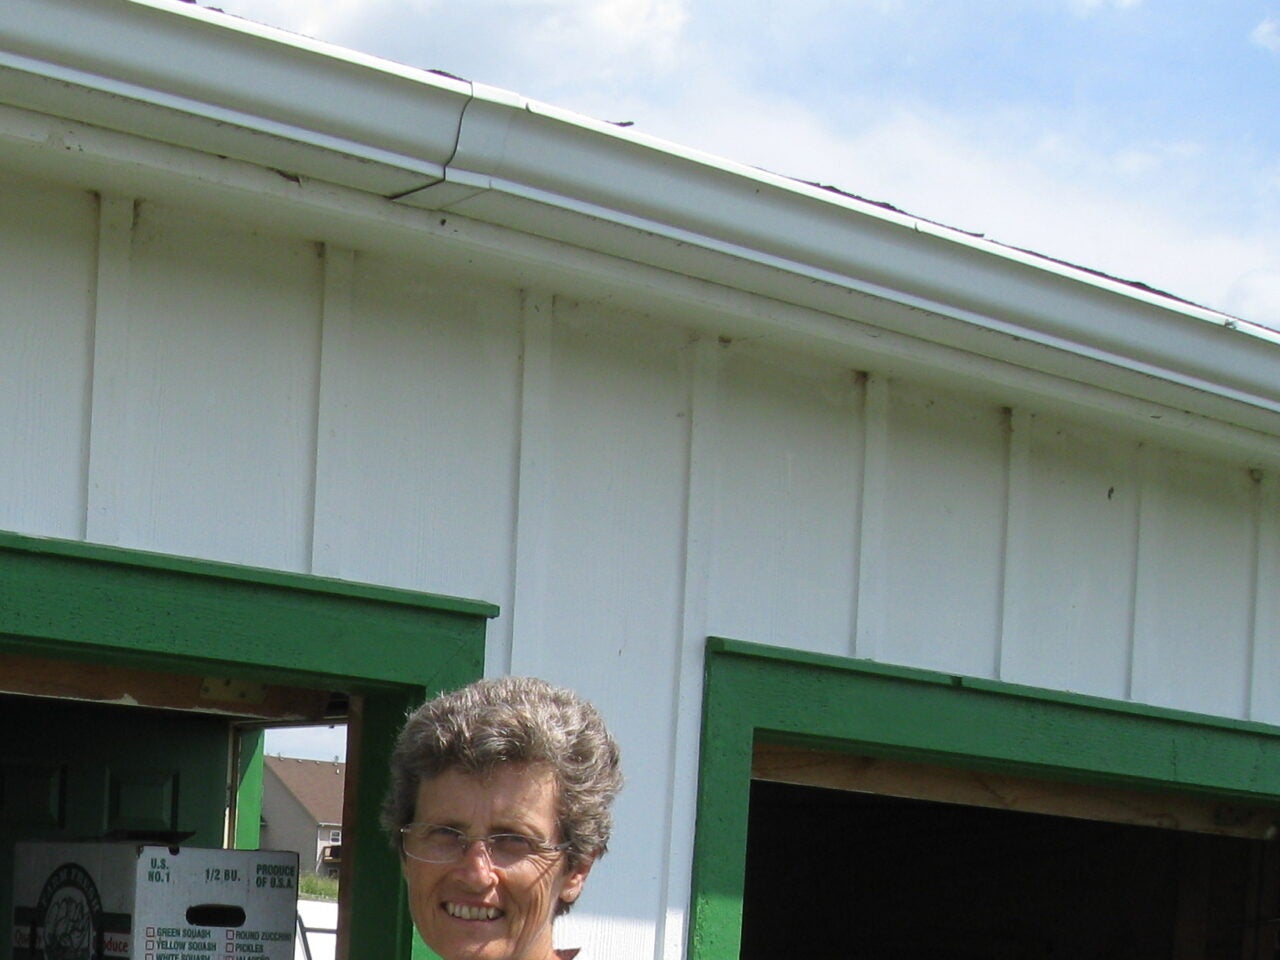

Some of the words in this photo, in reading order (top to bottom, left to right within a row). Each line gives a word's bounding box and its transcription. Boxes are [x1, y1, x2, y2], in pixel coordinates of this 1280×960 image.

[151, 858, 169, 869] U.S.
[206, 869, 220, 881] 1/2
[224, 869, 241, 881] BU.
[256, 864, 295, 876] PRODUCE
[256, 878, 267, 888] OF
[270, 878, 294, 888] U.S.A.
[157, 928, 180, 938] GREEN
[182, 928, 211, 939] SQUASH
[236, 931, 259, 940] ROUND
[157, 940, 185, 950] YELLOW
[188, 941, 216, 951] SQUASH
[235, 944, 263, 953] PICKLES
